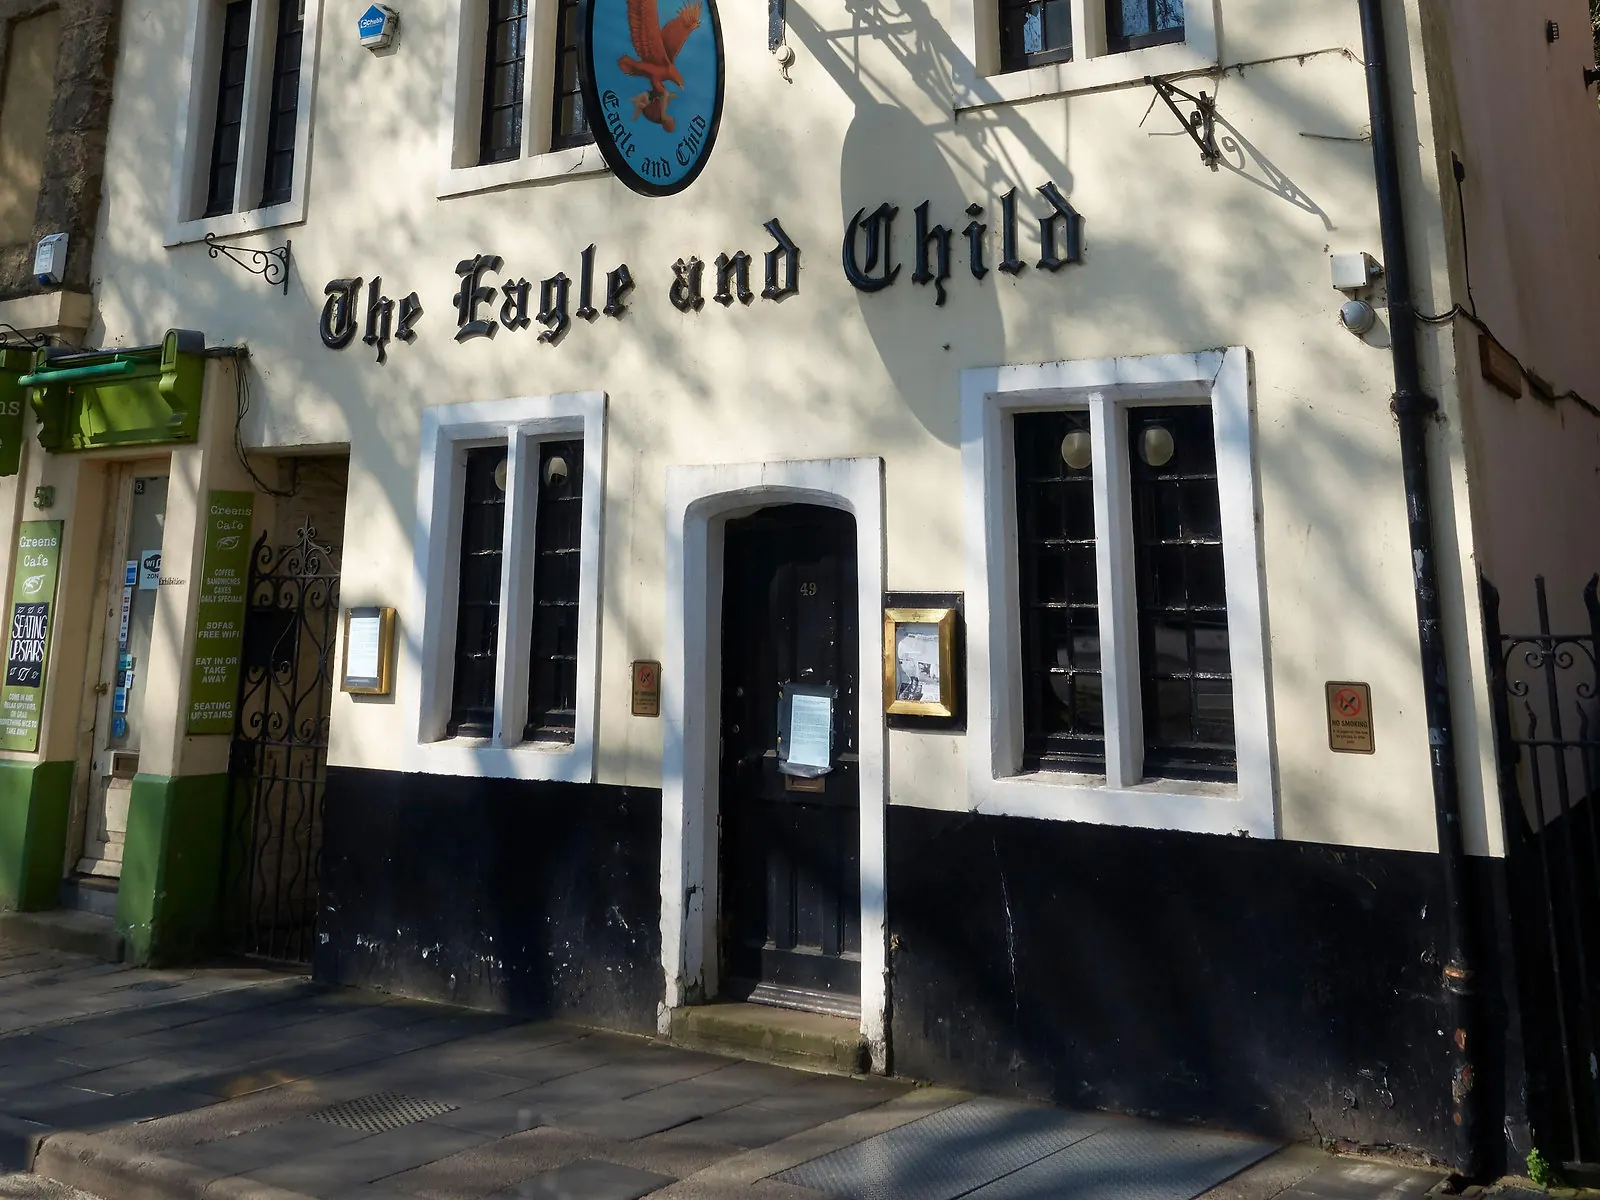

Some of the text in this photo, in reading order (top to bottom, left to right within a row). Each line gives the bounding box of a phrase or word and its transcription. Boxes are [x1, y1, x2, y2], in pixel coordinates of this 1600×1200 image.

[602, 90, 706, 178] Eagle and Child
[320, 181, 1086, 366] The Eagle and Child
[210, 505, 253, 516] Greens
[216, 520, 244, 530] Cafe
[19, 535, 57, 548] Greens
[23, 554, 48, 568] Cafe
[214, 569, 235, 577] COFFEE
[206, 577, 241, 585] SANDWICHES
[213, 586, 232, 594] CAKES
[800, 583, 817, 597] 49
[12, 614, 48, 640] SEATING
[206, 621, 234, 630] SOFAS
[198, 630, 240, 638] FREE WIFI
[9, 639, 45, 663] UPSTAIRS
[195, 656, 238, 666] EAT IN OR
[203, 666, 227, 674] TAKE
[201, 675, 227, 683] AWAY
[194, 702, 231, 711] SEATING
[190, 710, 233, 720] UPSTAIRS
[1341, 719, 1368, 728] SMOKING
